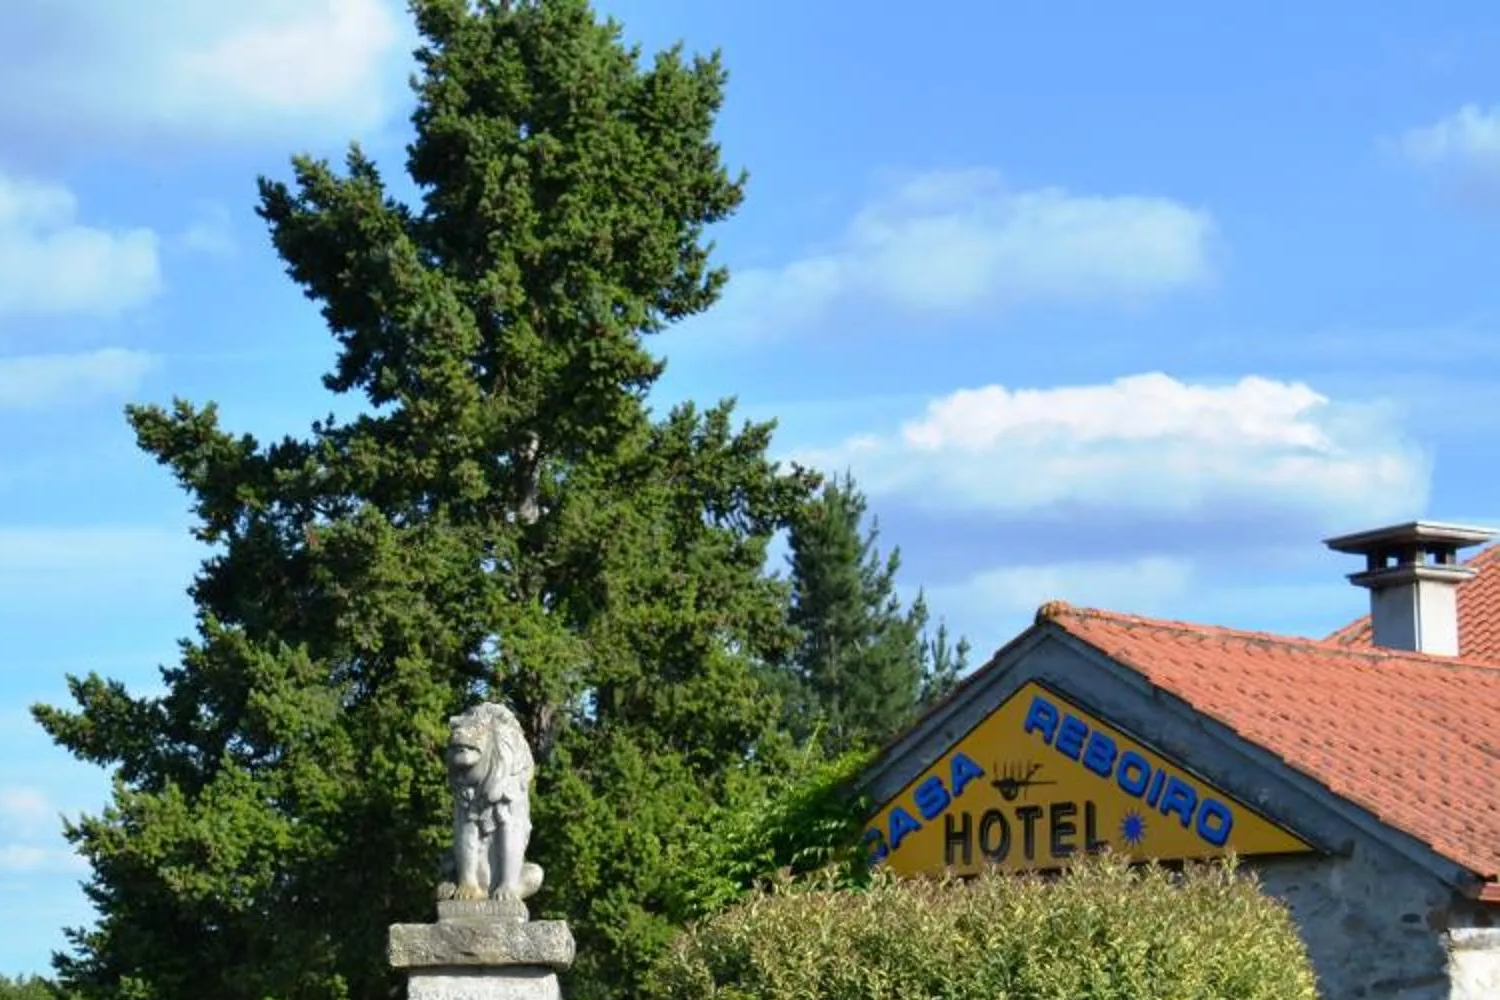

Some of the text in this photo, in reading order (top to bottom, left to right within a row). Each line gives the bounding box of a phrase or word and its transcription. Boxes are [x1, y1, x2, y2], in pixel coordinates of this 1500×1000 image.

[864, 696, 1233, 866] CASA REBOIRO
[943, 801, 1108, 866] HOTEL
